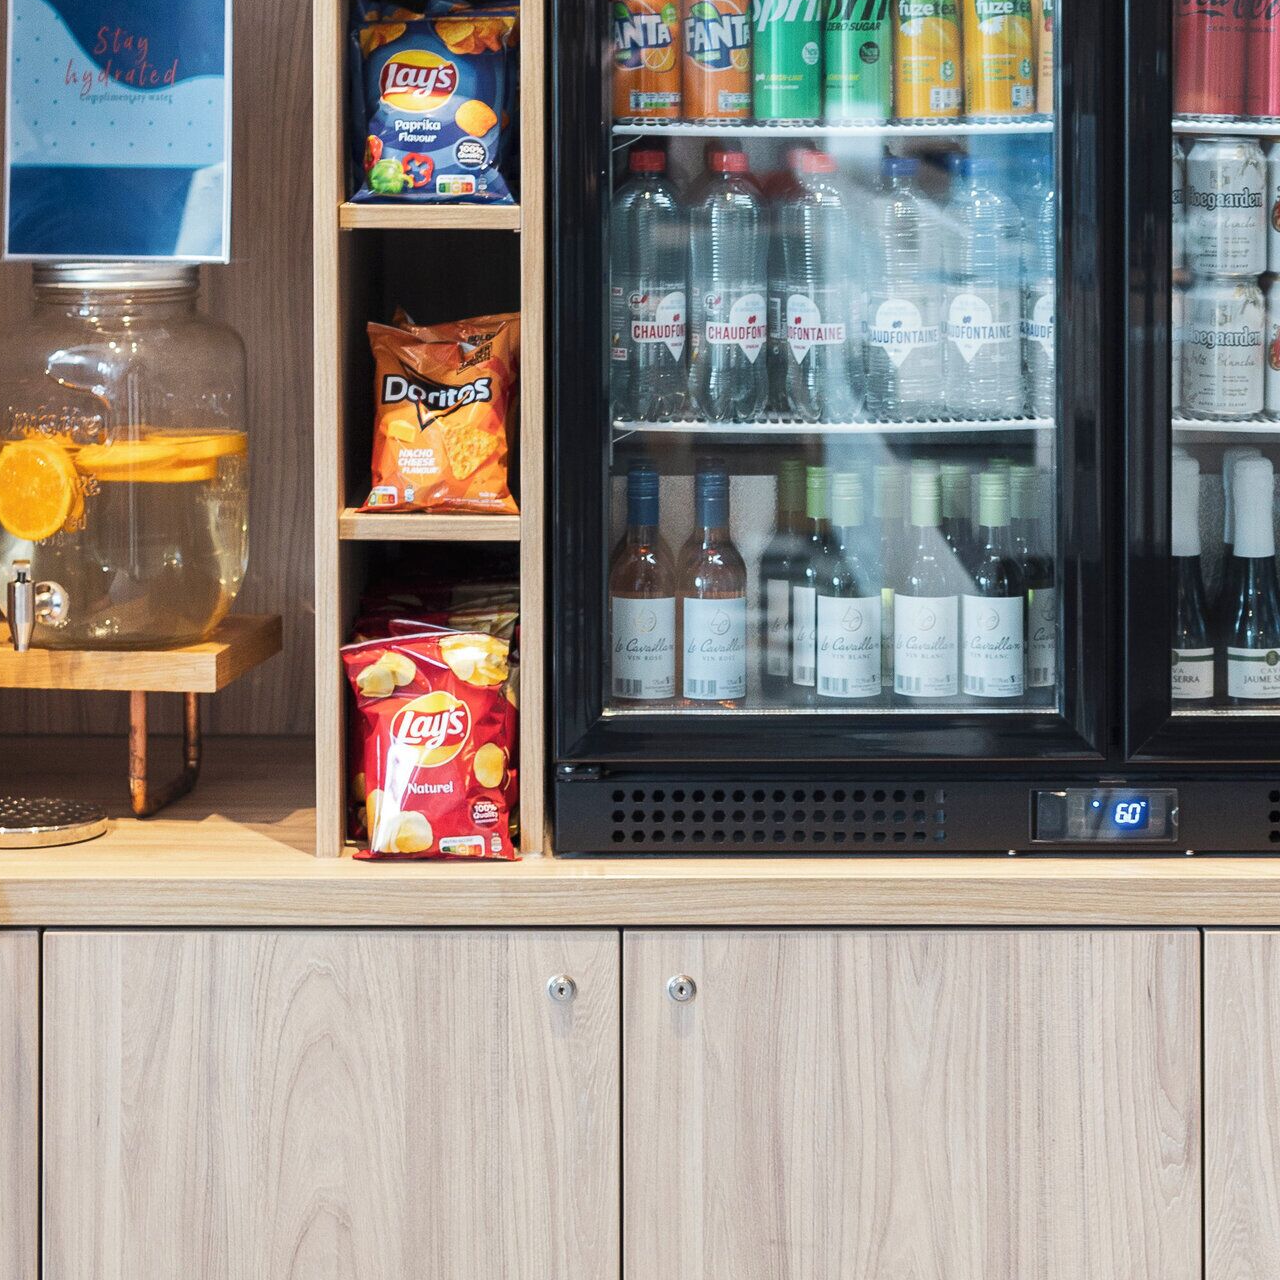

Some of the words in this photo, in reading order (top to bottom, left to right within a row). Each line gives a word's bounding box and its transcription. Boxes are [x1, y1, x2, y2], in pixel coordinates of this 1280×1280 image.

[848, 21, 881, 32] SUGAR
[94, 25, 149, 63] Stay
[64, 58, 179, 96] hydrated
[384, 62, 454, 97] Lay's
[394, 119, 441, 133] Paprika
[398, 132, 437, 143] Flavour
[384, 376, 490, 408] Doritos
[398, 448, 433, 459] NACHO
[397, 457, 435, 467] CHEESE
[1244, 674, 1272, 685] JAUME
[398, 708, 465, 749] Lay's
[408, 780, 453, 795] Naturel
[473, 803, 498, 813] 100%
[473, 810, 500, 821] Quality
